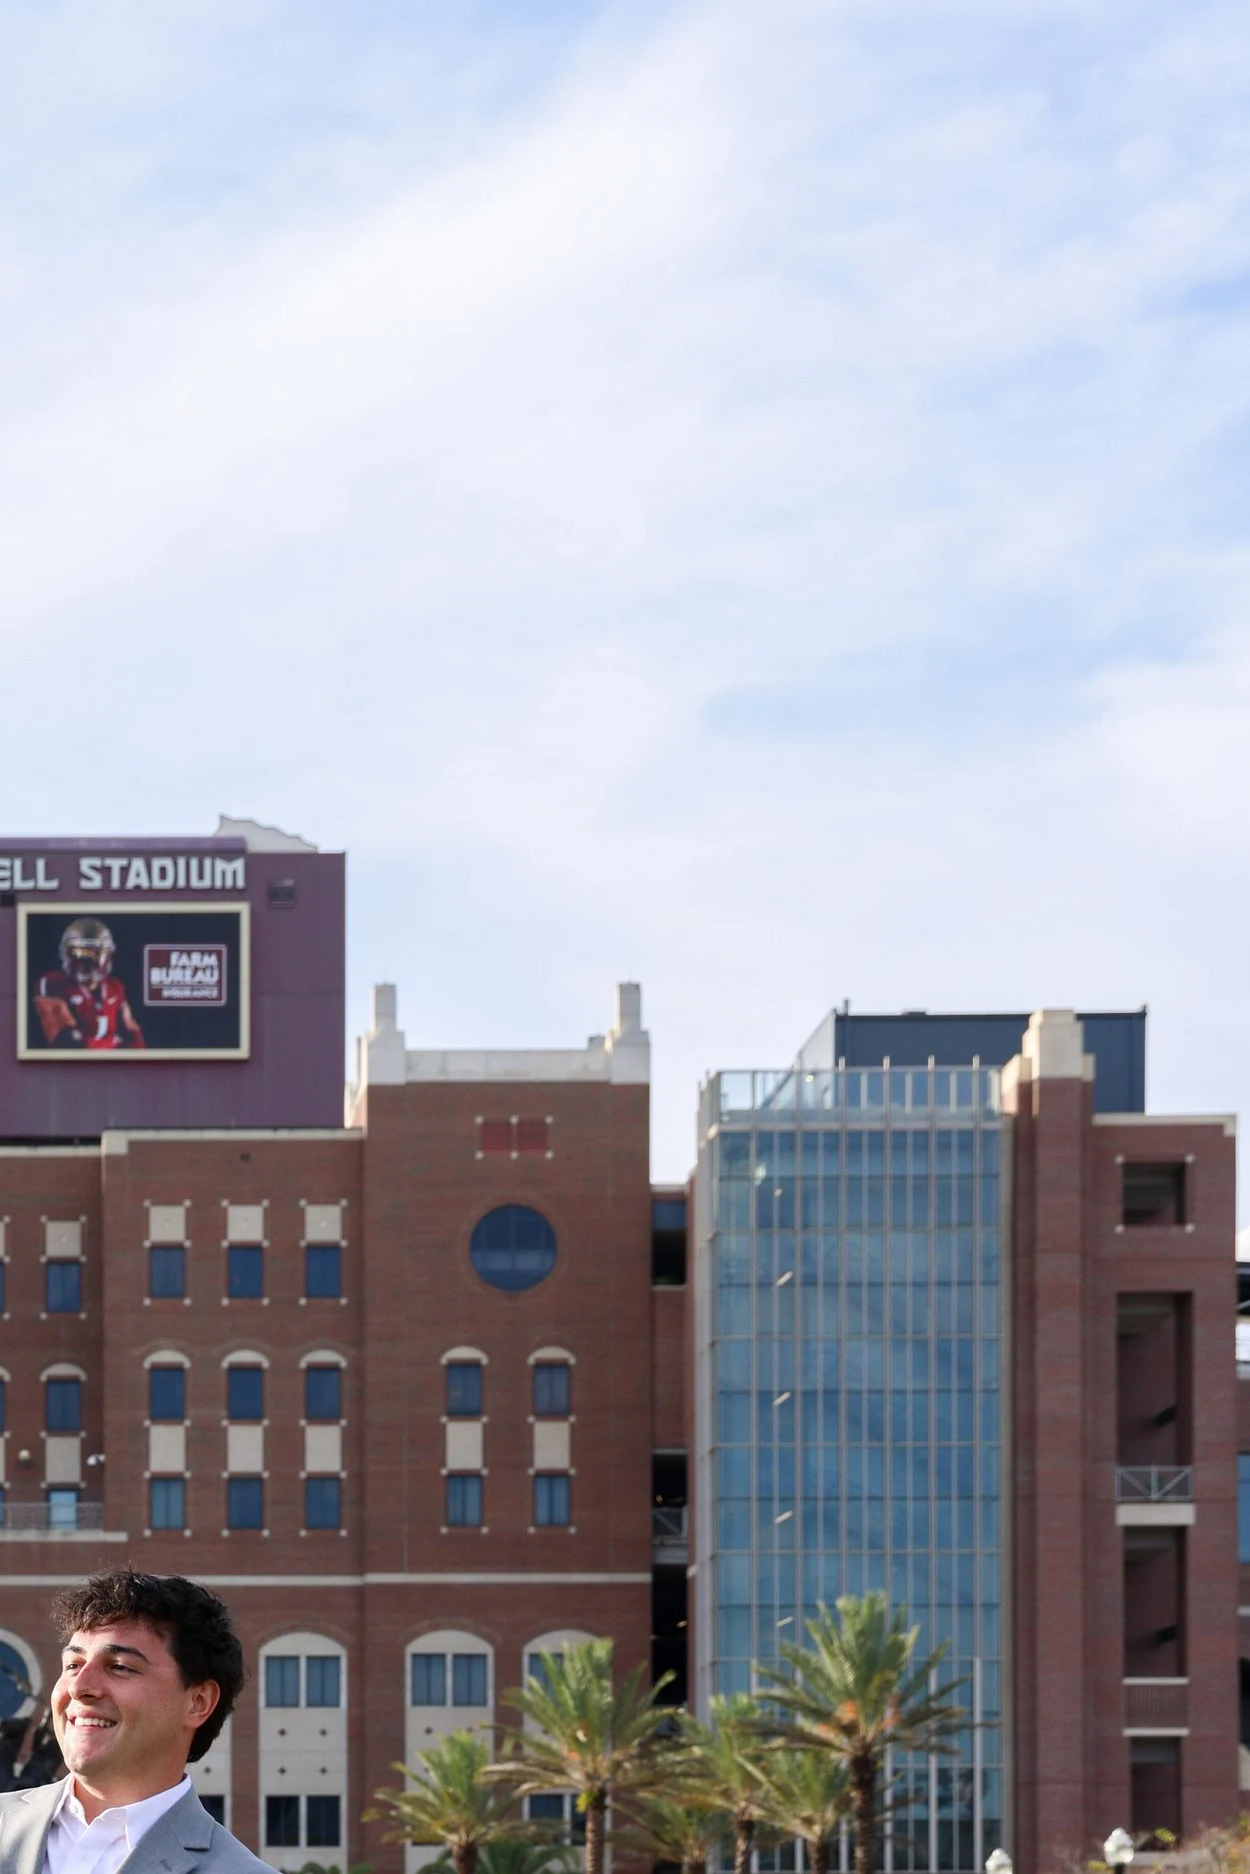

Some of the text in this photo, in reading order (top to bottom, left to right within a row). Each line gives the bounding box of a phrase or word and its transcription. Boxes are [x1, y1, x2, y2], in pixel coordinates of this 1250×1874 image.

[79, 857, 245, 890] STADIUM
[170, 951, 218, 967] FARM
[150, 967, 219, 985] BUREAU
